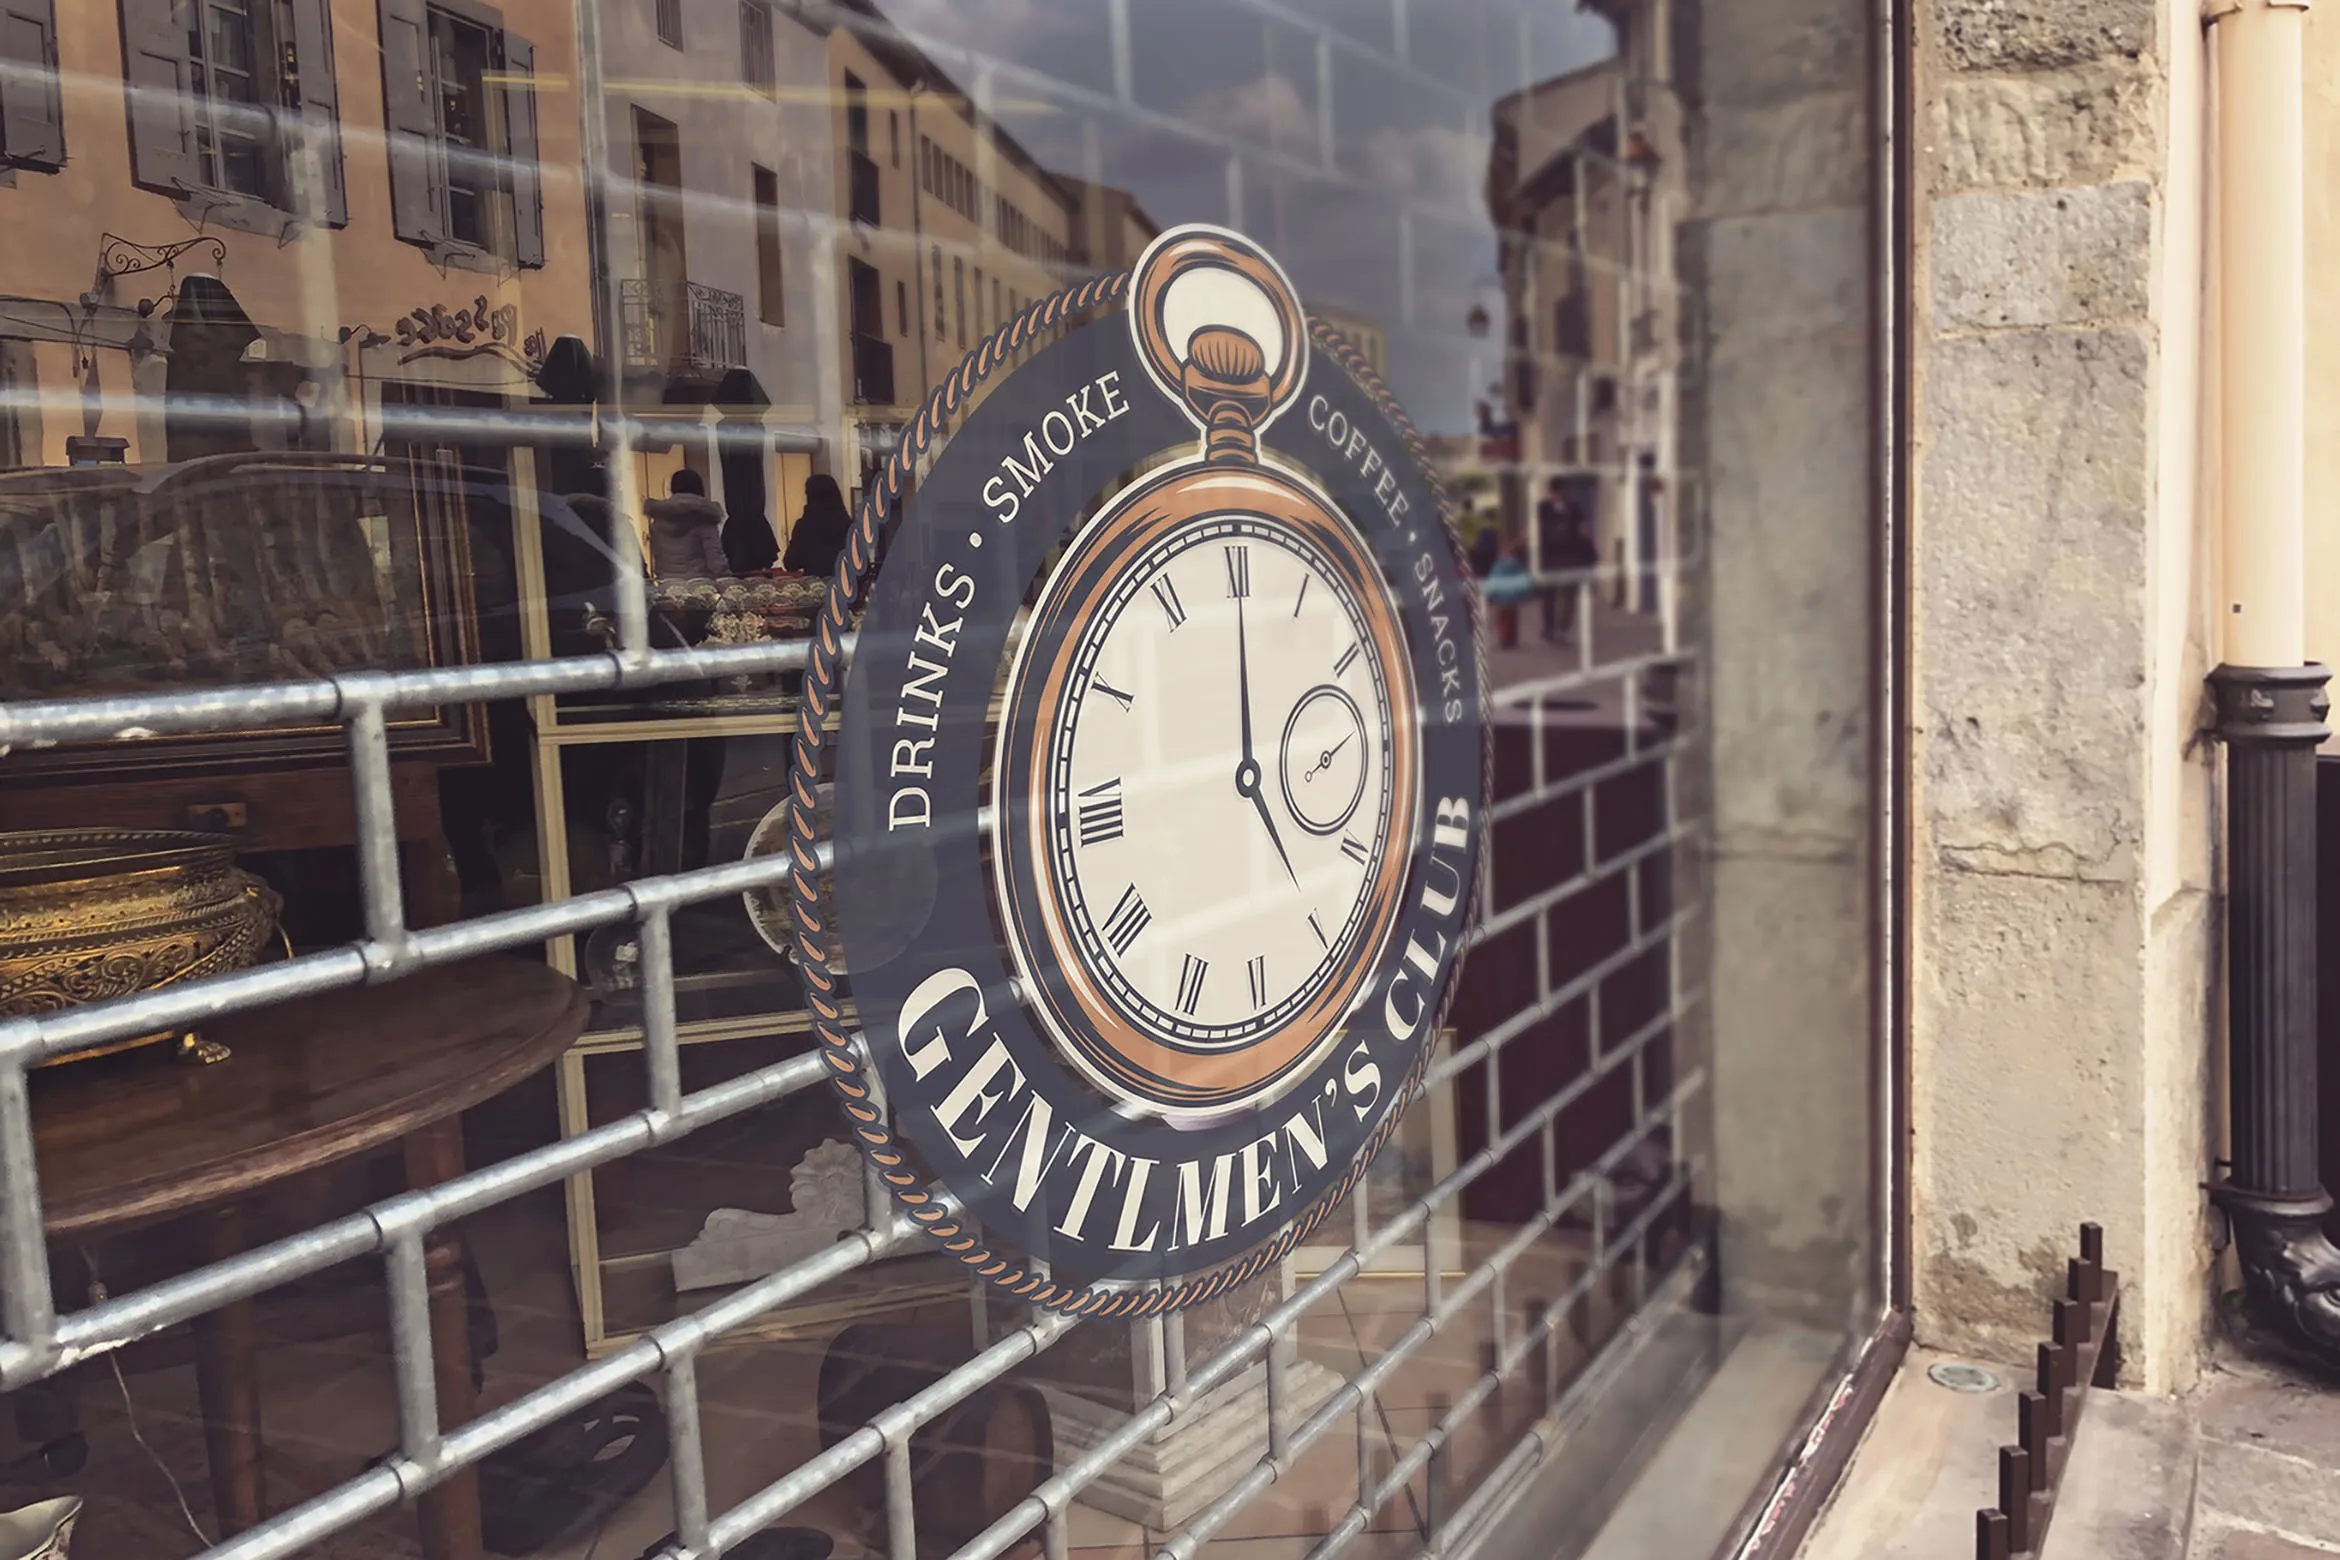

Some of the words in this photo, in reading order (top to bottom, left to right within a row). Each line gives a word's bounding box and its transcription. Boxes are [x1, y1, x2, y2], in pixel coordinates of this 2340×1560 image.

[888, 563, 976, 832] DRINKS
[982, 370, 1131, 524] SMOKE
[1309, 394, 1410, 528] COFFEE
[1414, 552, 1463, 724] SNACKS
[897, 967, 1382, 1253] GENTLMEN'S
[1384, 796, 1470, 1041] CLUB
